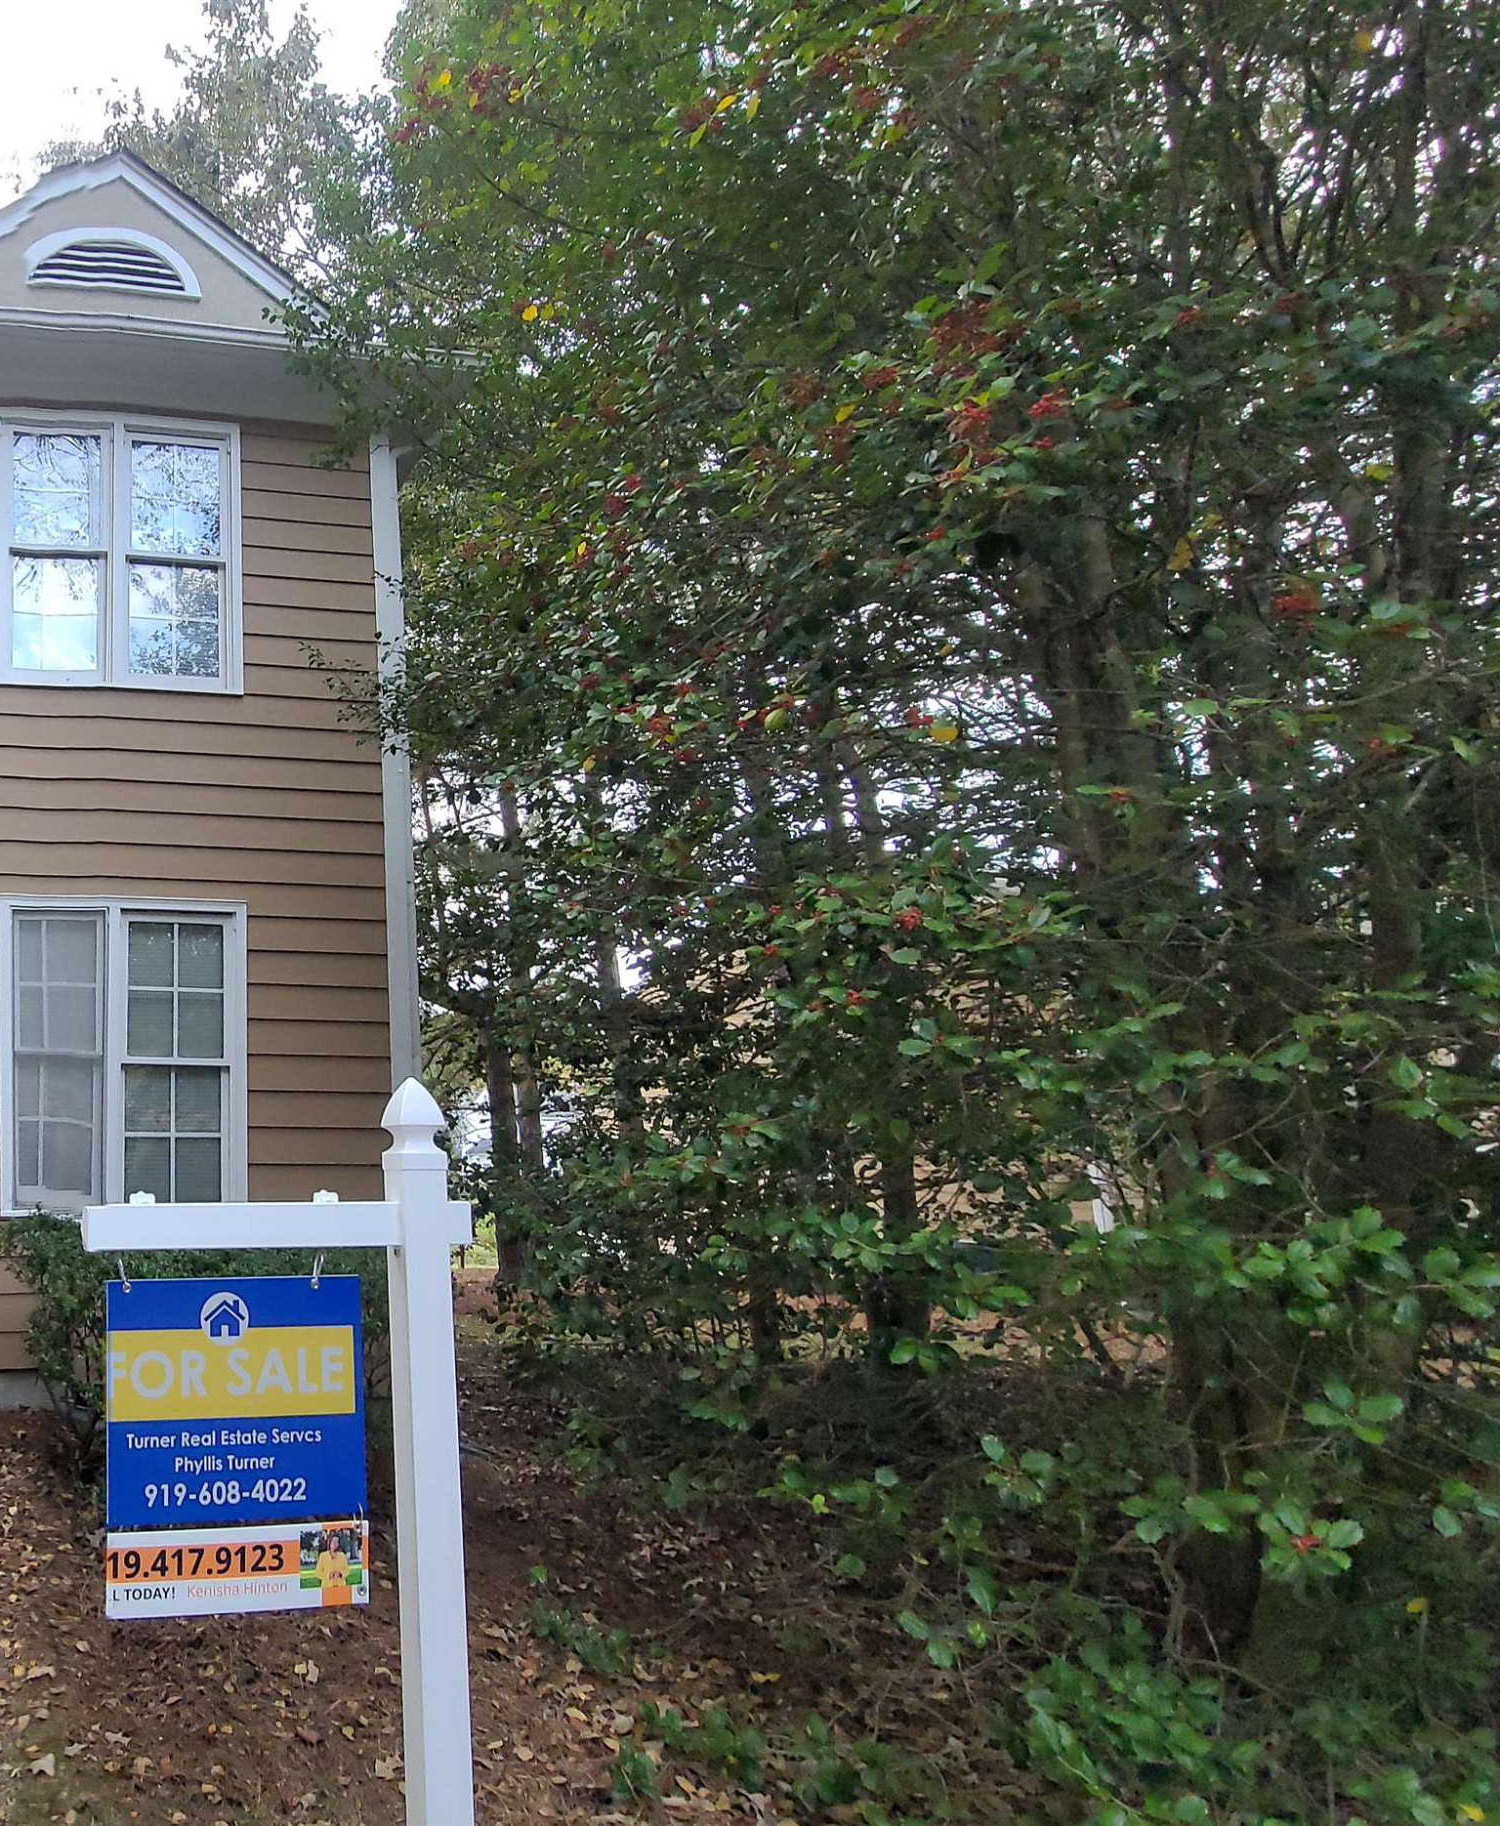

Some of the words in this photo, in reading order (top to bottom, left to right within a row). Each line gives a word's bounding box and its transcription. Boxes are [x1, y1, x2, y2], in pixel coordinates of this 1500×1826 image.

[108, 1350, 208, 1399] FOR
[226, 1346, 344, 1397] SALE
[126, 1433, 176, 1450] Turner
[181, 1430, 216, 1448] Real
[221, 1429, 267, 1446] Estate
[272, 1428, 322, 1445] Servcs
[174, 1454, 223, 1476] Phyllis
[227, 1455, 275, 1471] Turner
[144, 1477, 307, 1508] 919-608-4022
[124, 1586, 175, 1602] TODAY!
[187, 1582, 240, 1599] Kenisha
[243, 1580, 289, 1596] Hinton
